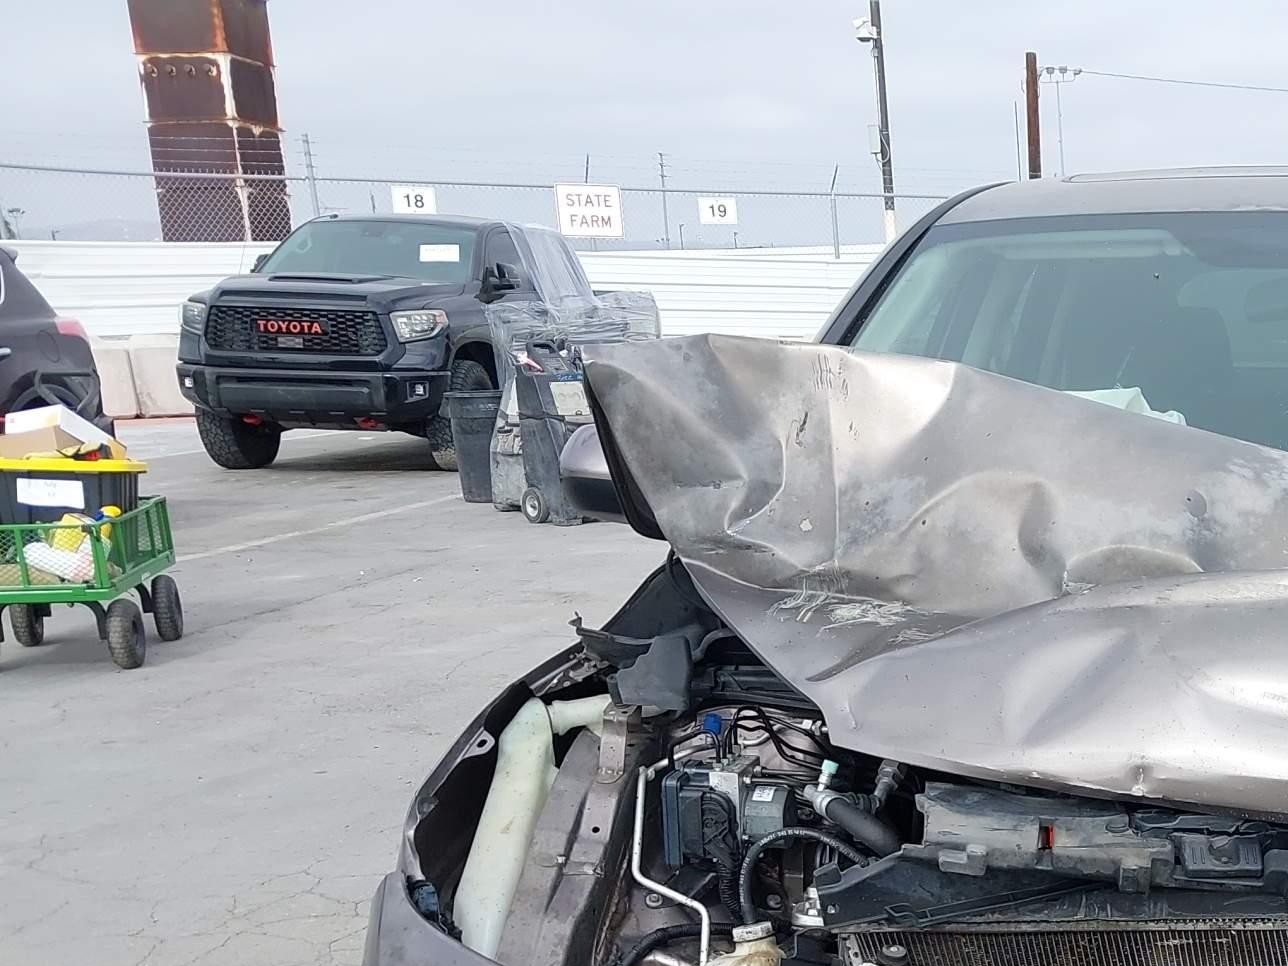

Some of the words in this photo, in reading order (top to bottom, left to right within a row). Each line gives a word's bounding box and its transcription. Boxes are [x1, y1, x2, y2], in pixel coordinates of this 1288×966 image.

[402, 193, 425, 209] 18
[565, 193, 613, 208] STATE
[708, 204, 727, 218] 19
[569, 214, 612, 229] FARM
[256, 320, 323, 334] TOYOTA
